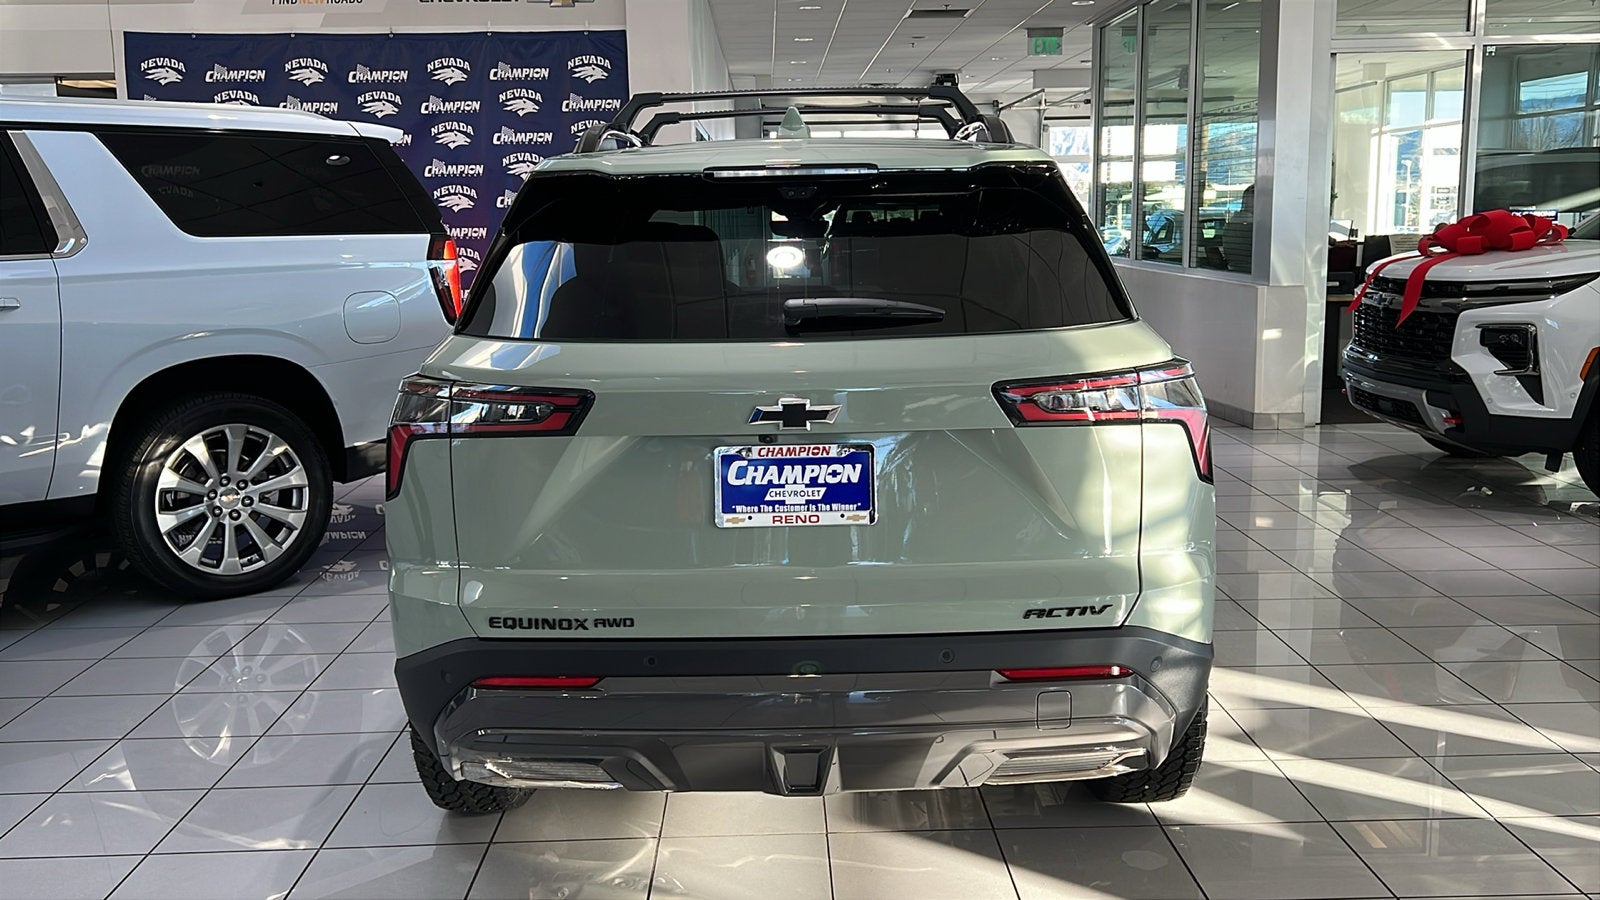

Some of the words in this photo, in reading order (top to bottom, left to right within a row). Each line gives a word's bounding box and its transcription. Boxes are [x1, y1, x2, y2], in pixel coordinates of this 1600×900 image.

[141, 58, 186, 72] NEVADA
[285, 58, 328, 73] NEVADA
[427, 58, 471, 72] NEVADA
[567, 55, 611, 70] NEVADA
[205, 70, 266, 82] CHAMPION
[348, 70, 408, 83] CHAMPION
[490, 68, 549, 80] CHAMPION
[214, 90, 259, 104] NEVADA
[357, 91, 402, 105] NEVADA
[499, 89, 542, 102] NEVADA
[421, 101, 480, 114] CHAMPION
[562, 99, 621, 112] CHAMPION
[431, 121, 474, 136] NEVADA
[570, 120, 606, 134] NEVA
[493, 132, 553, 145] CHAMPION
[424, 164, 484, 177] CHAMPION
[433, 185, 478, 199] NEVADA
[447, 227, 487, 238] MPION
[757, 446, 832, 458] CHAMPION
[727, 460, 862, 486] CHAMPION
[769, 489, 822, 498] CHEVROLET
[760, 504, 774, 513] The
[774, 504, 808, 513] Customer
[817, 503, 831, 512] The
[772, 514, 820, 525] RENO
[1022, 604, 1114, 620] ACTIV
[488, 616, 590, 631] EQUINOX
[593, 617, 635, 628] AWD
